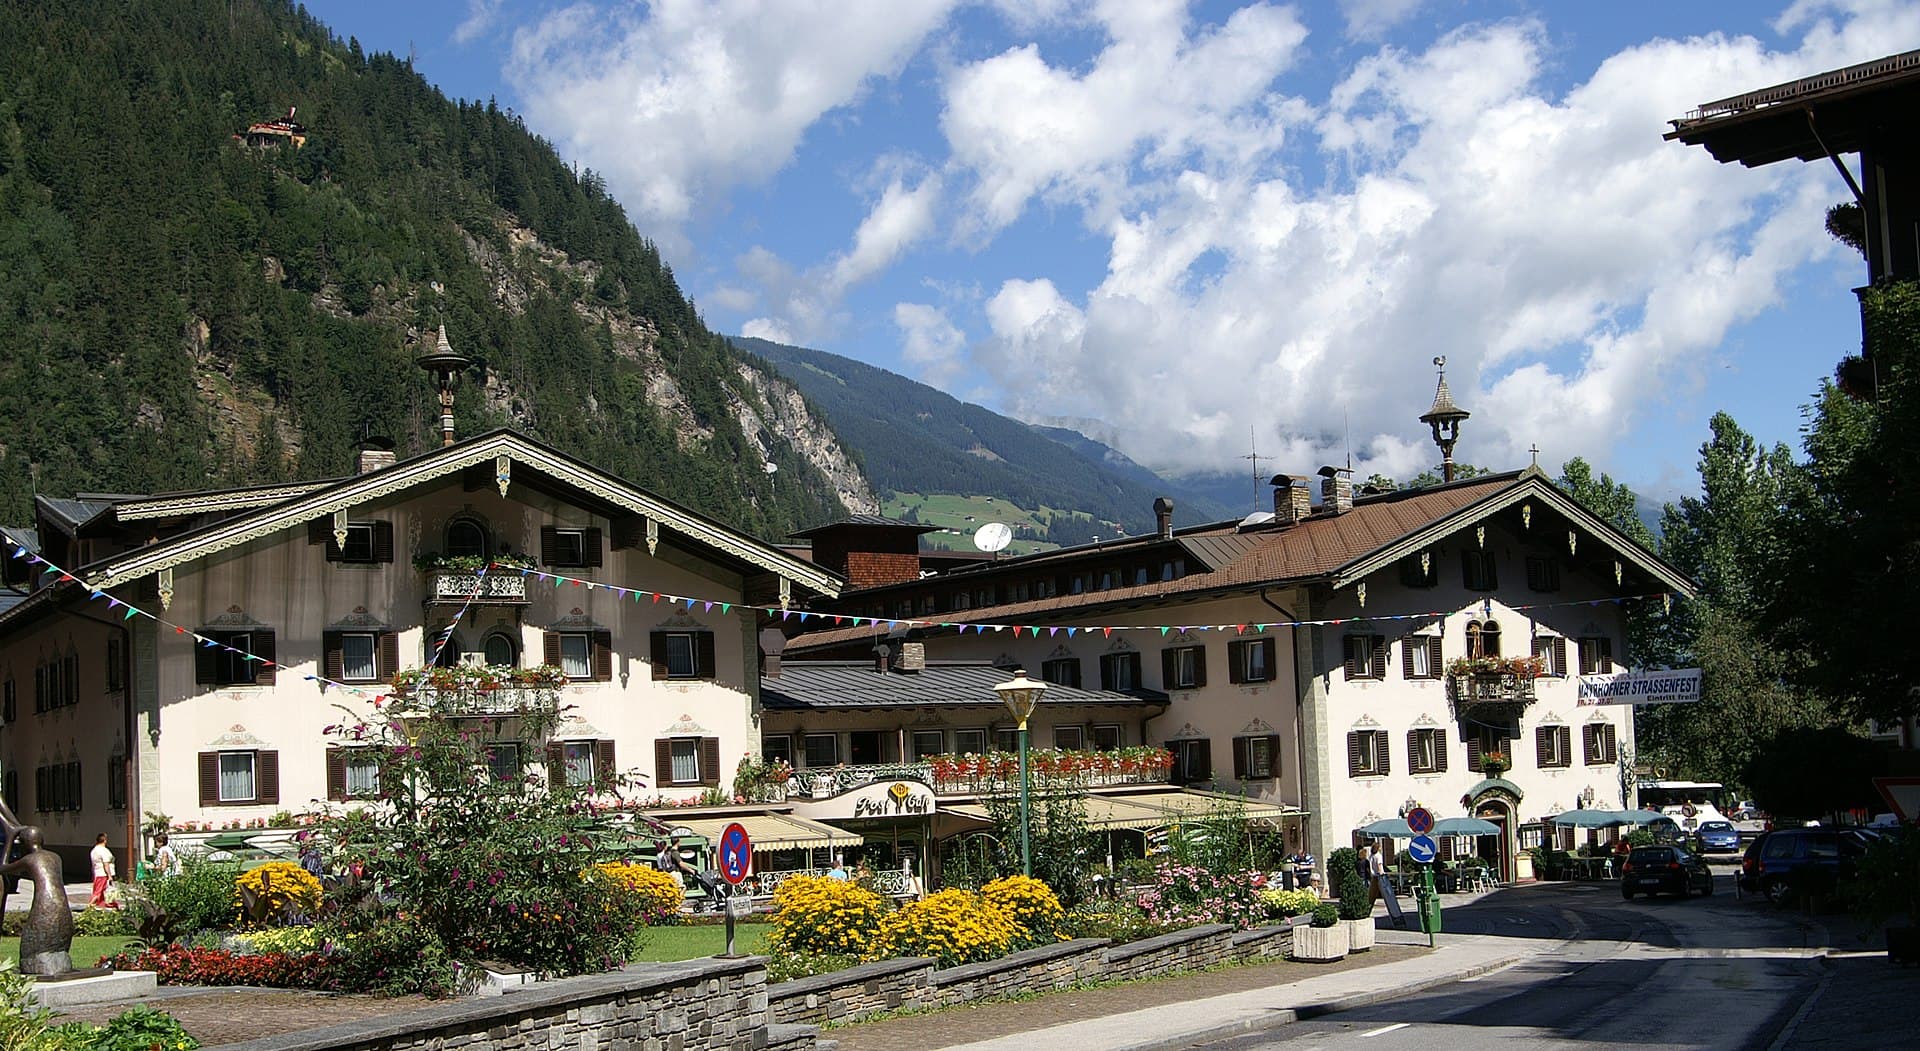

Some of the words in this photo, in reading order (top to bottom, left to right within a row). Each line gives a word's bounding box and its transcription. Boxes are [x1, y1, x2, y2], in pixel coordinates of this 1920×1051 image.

[1578, 680, 1630, 698] MAYRHOFNER
[1631, 677, 1698, 694] STRASSENFEST
[855, 796, 889, 817] Post
